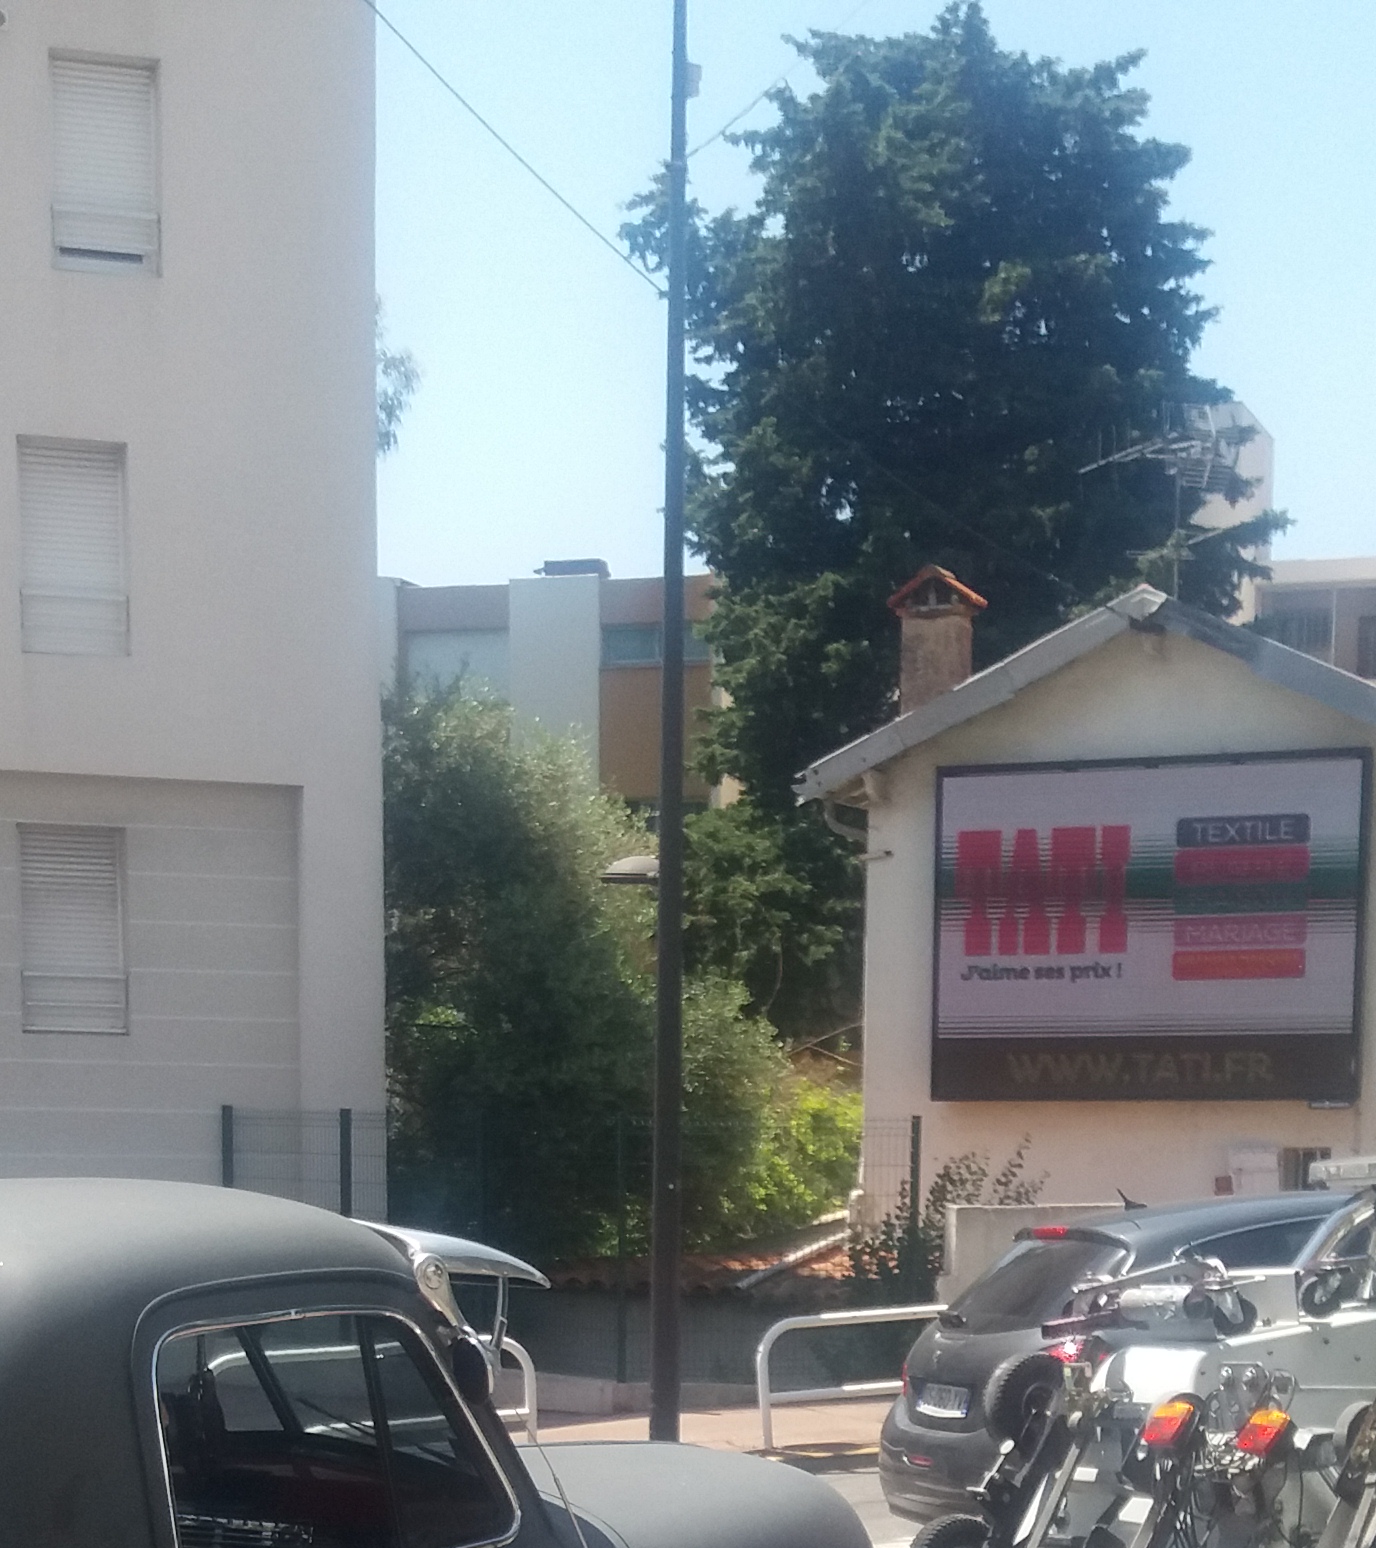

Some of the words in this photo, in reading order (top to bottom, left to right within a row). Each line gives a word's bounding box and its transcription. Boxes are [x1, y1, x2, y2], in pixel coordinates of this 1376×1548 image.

[1193, 819, 1295, 842] TEXTILE
[1185, 922, 1297, 943] MARIAGE
[960, 963, 1030, 981] J'aime
[1034, 965, 1065, 980] ses
[1070, 961, 1111, 983] prix
[1006, 1048, 1274, 1086] WWW.TATI.FR
